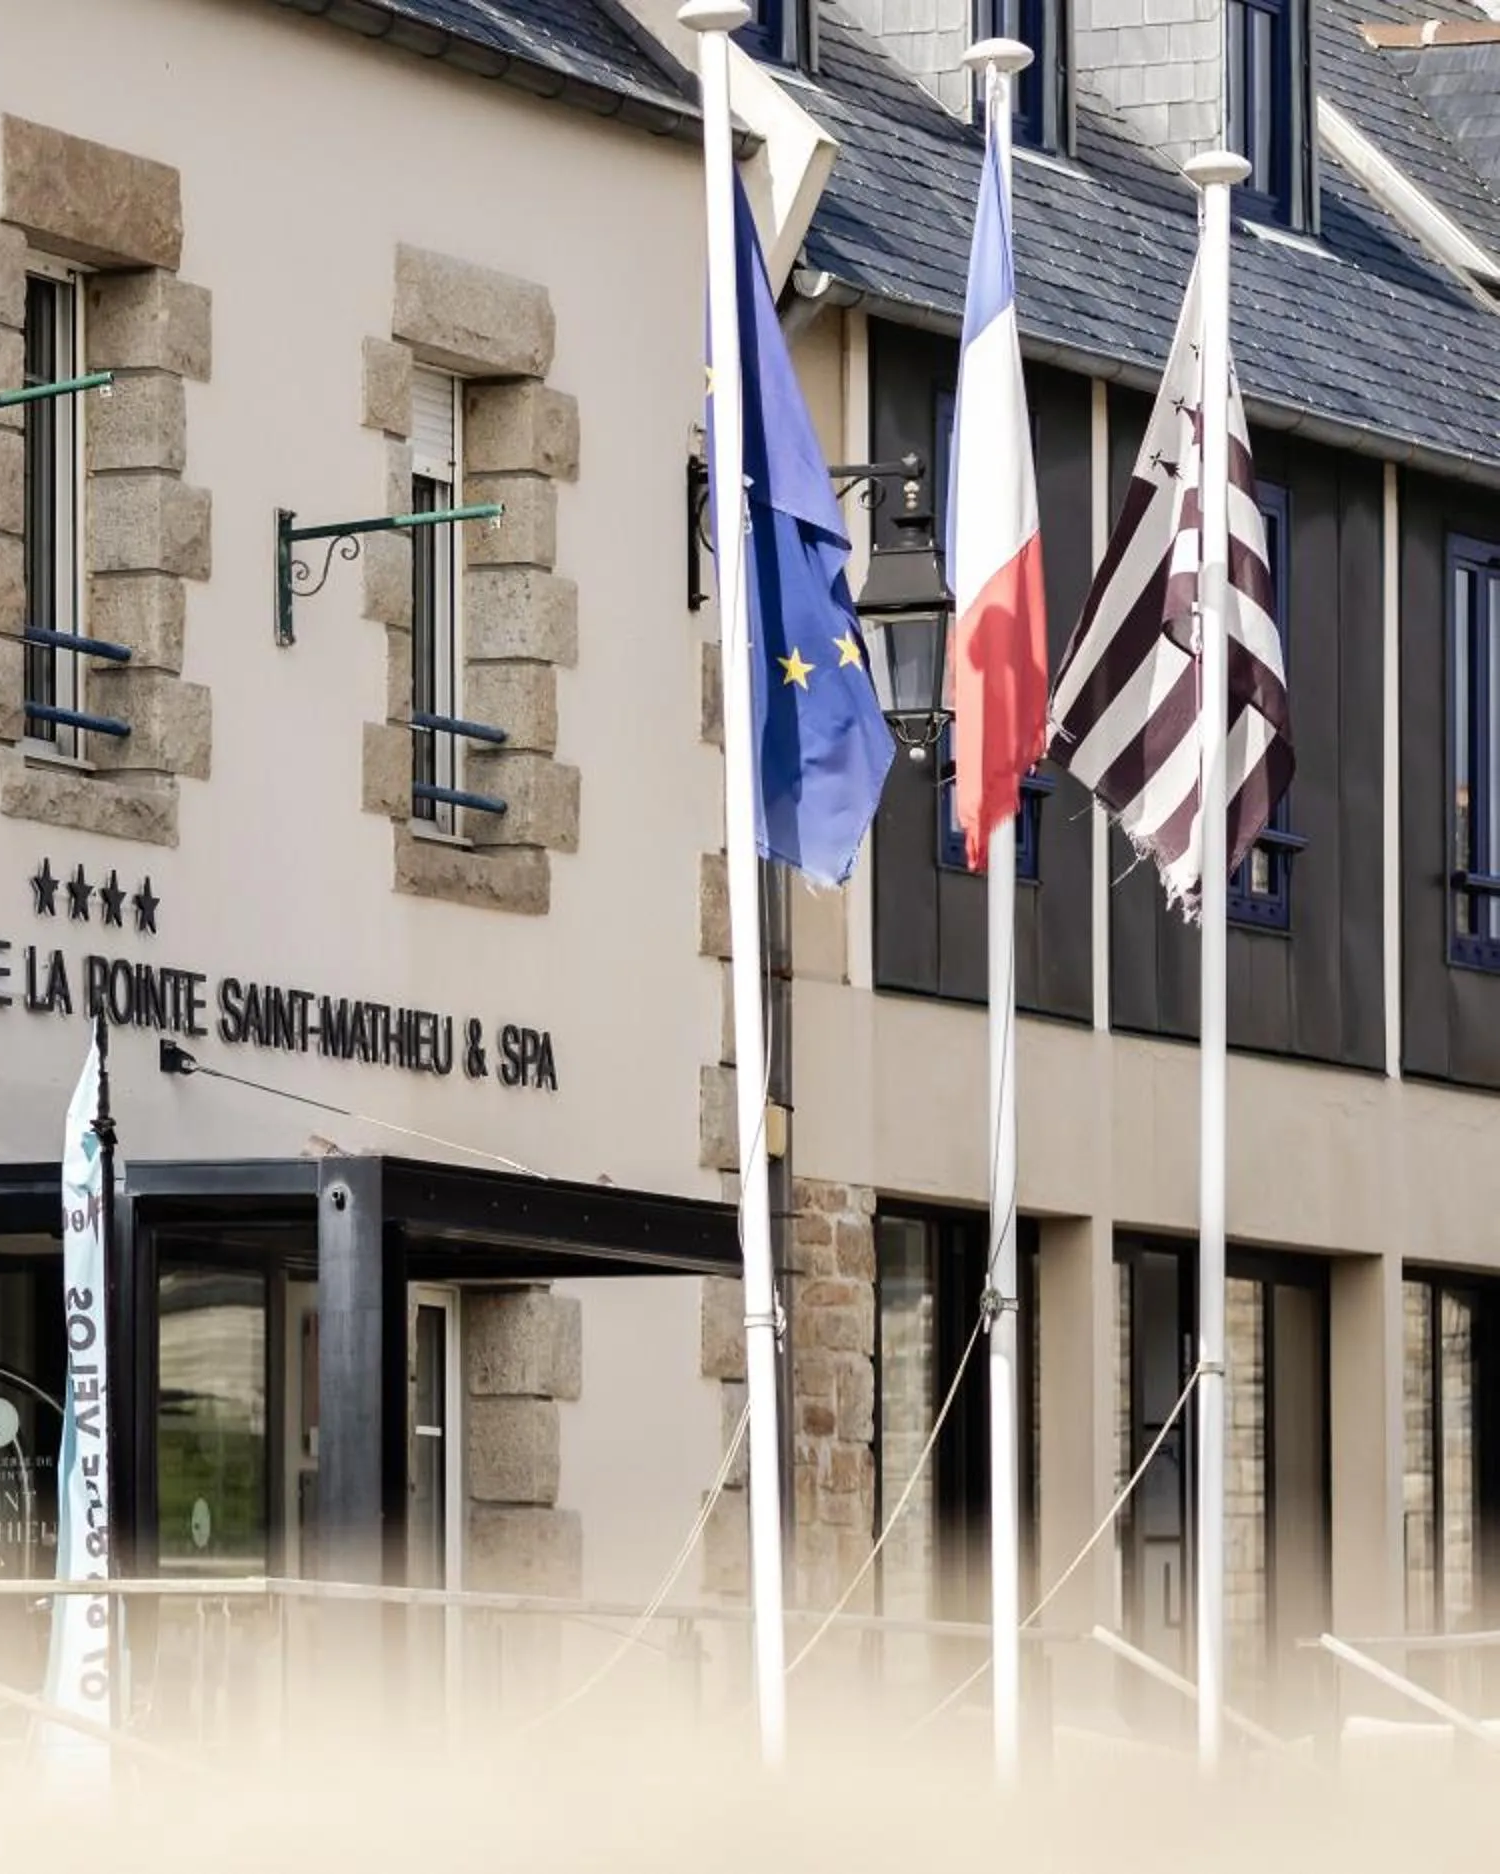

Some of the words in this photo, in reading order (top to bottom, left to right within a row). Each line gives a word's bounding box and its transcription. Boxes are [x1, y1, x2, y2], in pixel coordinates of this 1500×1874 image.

[25, 945, 73, 1014] LA
[85, 955, 207, 1036] POINTE
[218, 977, 453, 1076] SAINT-MATHIEU
[464, 1018, 489, 1078] &
[500, 1024, 559, 1091] SPA
